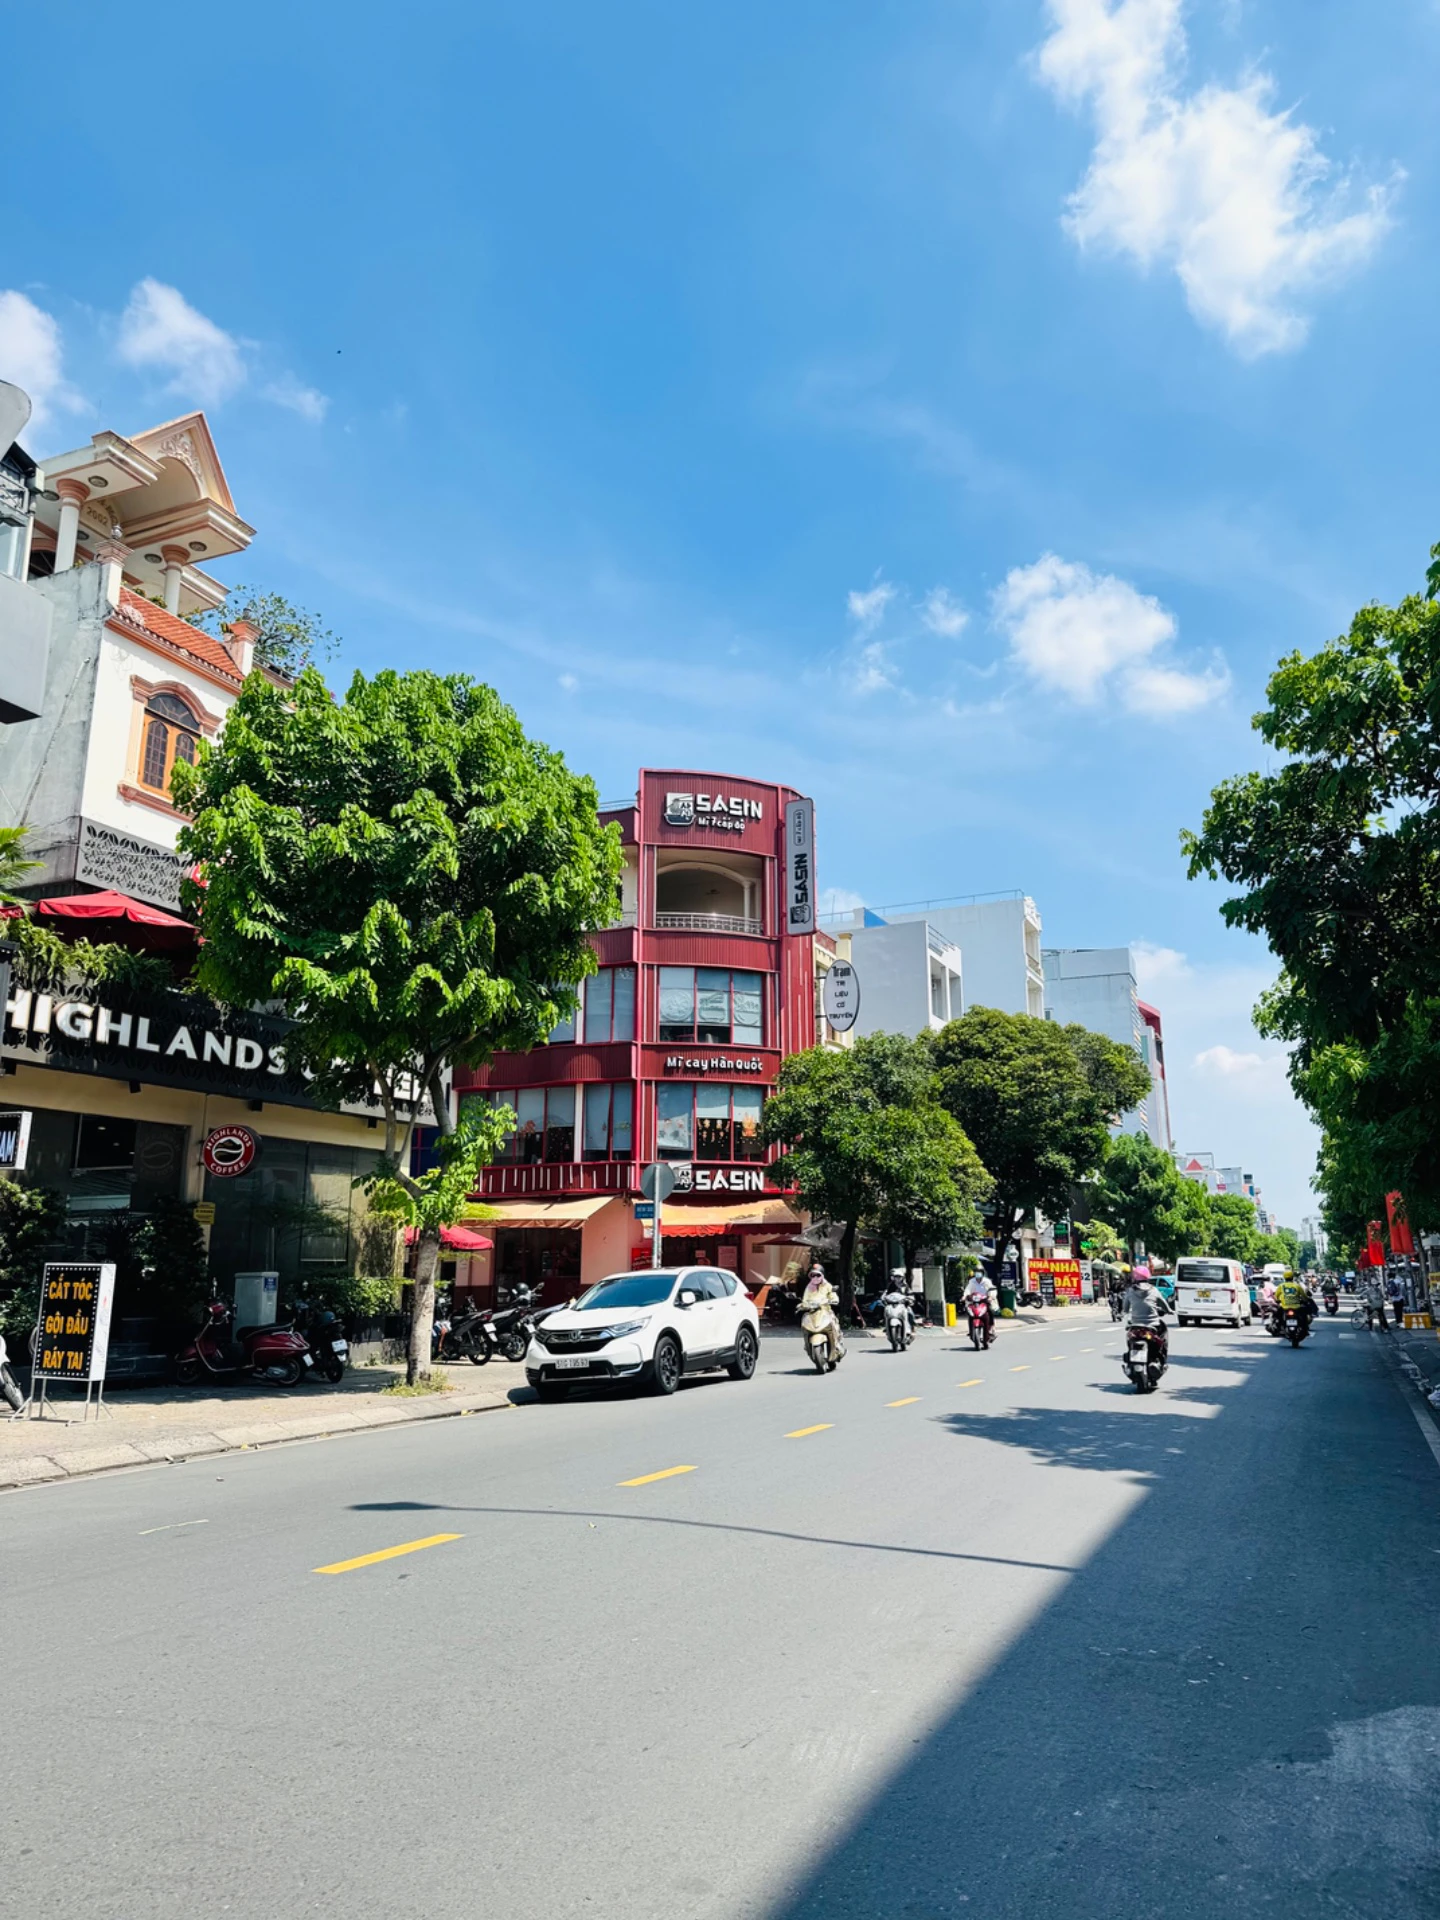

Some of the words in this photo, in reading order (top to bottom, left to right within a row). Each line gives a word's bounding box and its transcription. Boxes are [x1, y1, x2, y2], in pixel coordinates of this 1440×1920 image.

[696, 794, 763, 820] SASIN
[794, 853, 809, 904] SASIN
[6, 988, 288, 1076] HIGHLANDS
[667, 1056, 684, 1067] Mì
[685, 1058, 708, 1071] cay
[710, 1056, 734, 1069] Hàn
[735, 1057, 764, 1071] Quốc
[206, 1128, 252, 1150] HIGHLANDS
[210, 1160, 246, 1174] COFFEE
[695, 1169, 764, 1191] SASIN
[1049, 1260, 1080, 1273] NHÀ
[72, 1277, 94, 1301] TÓC
[42, 1345, 65, 1369] RÁY
[66, 1350, 84, 1370] TAI
